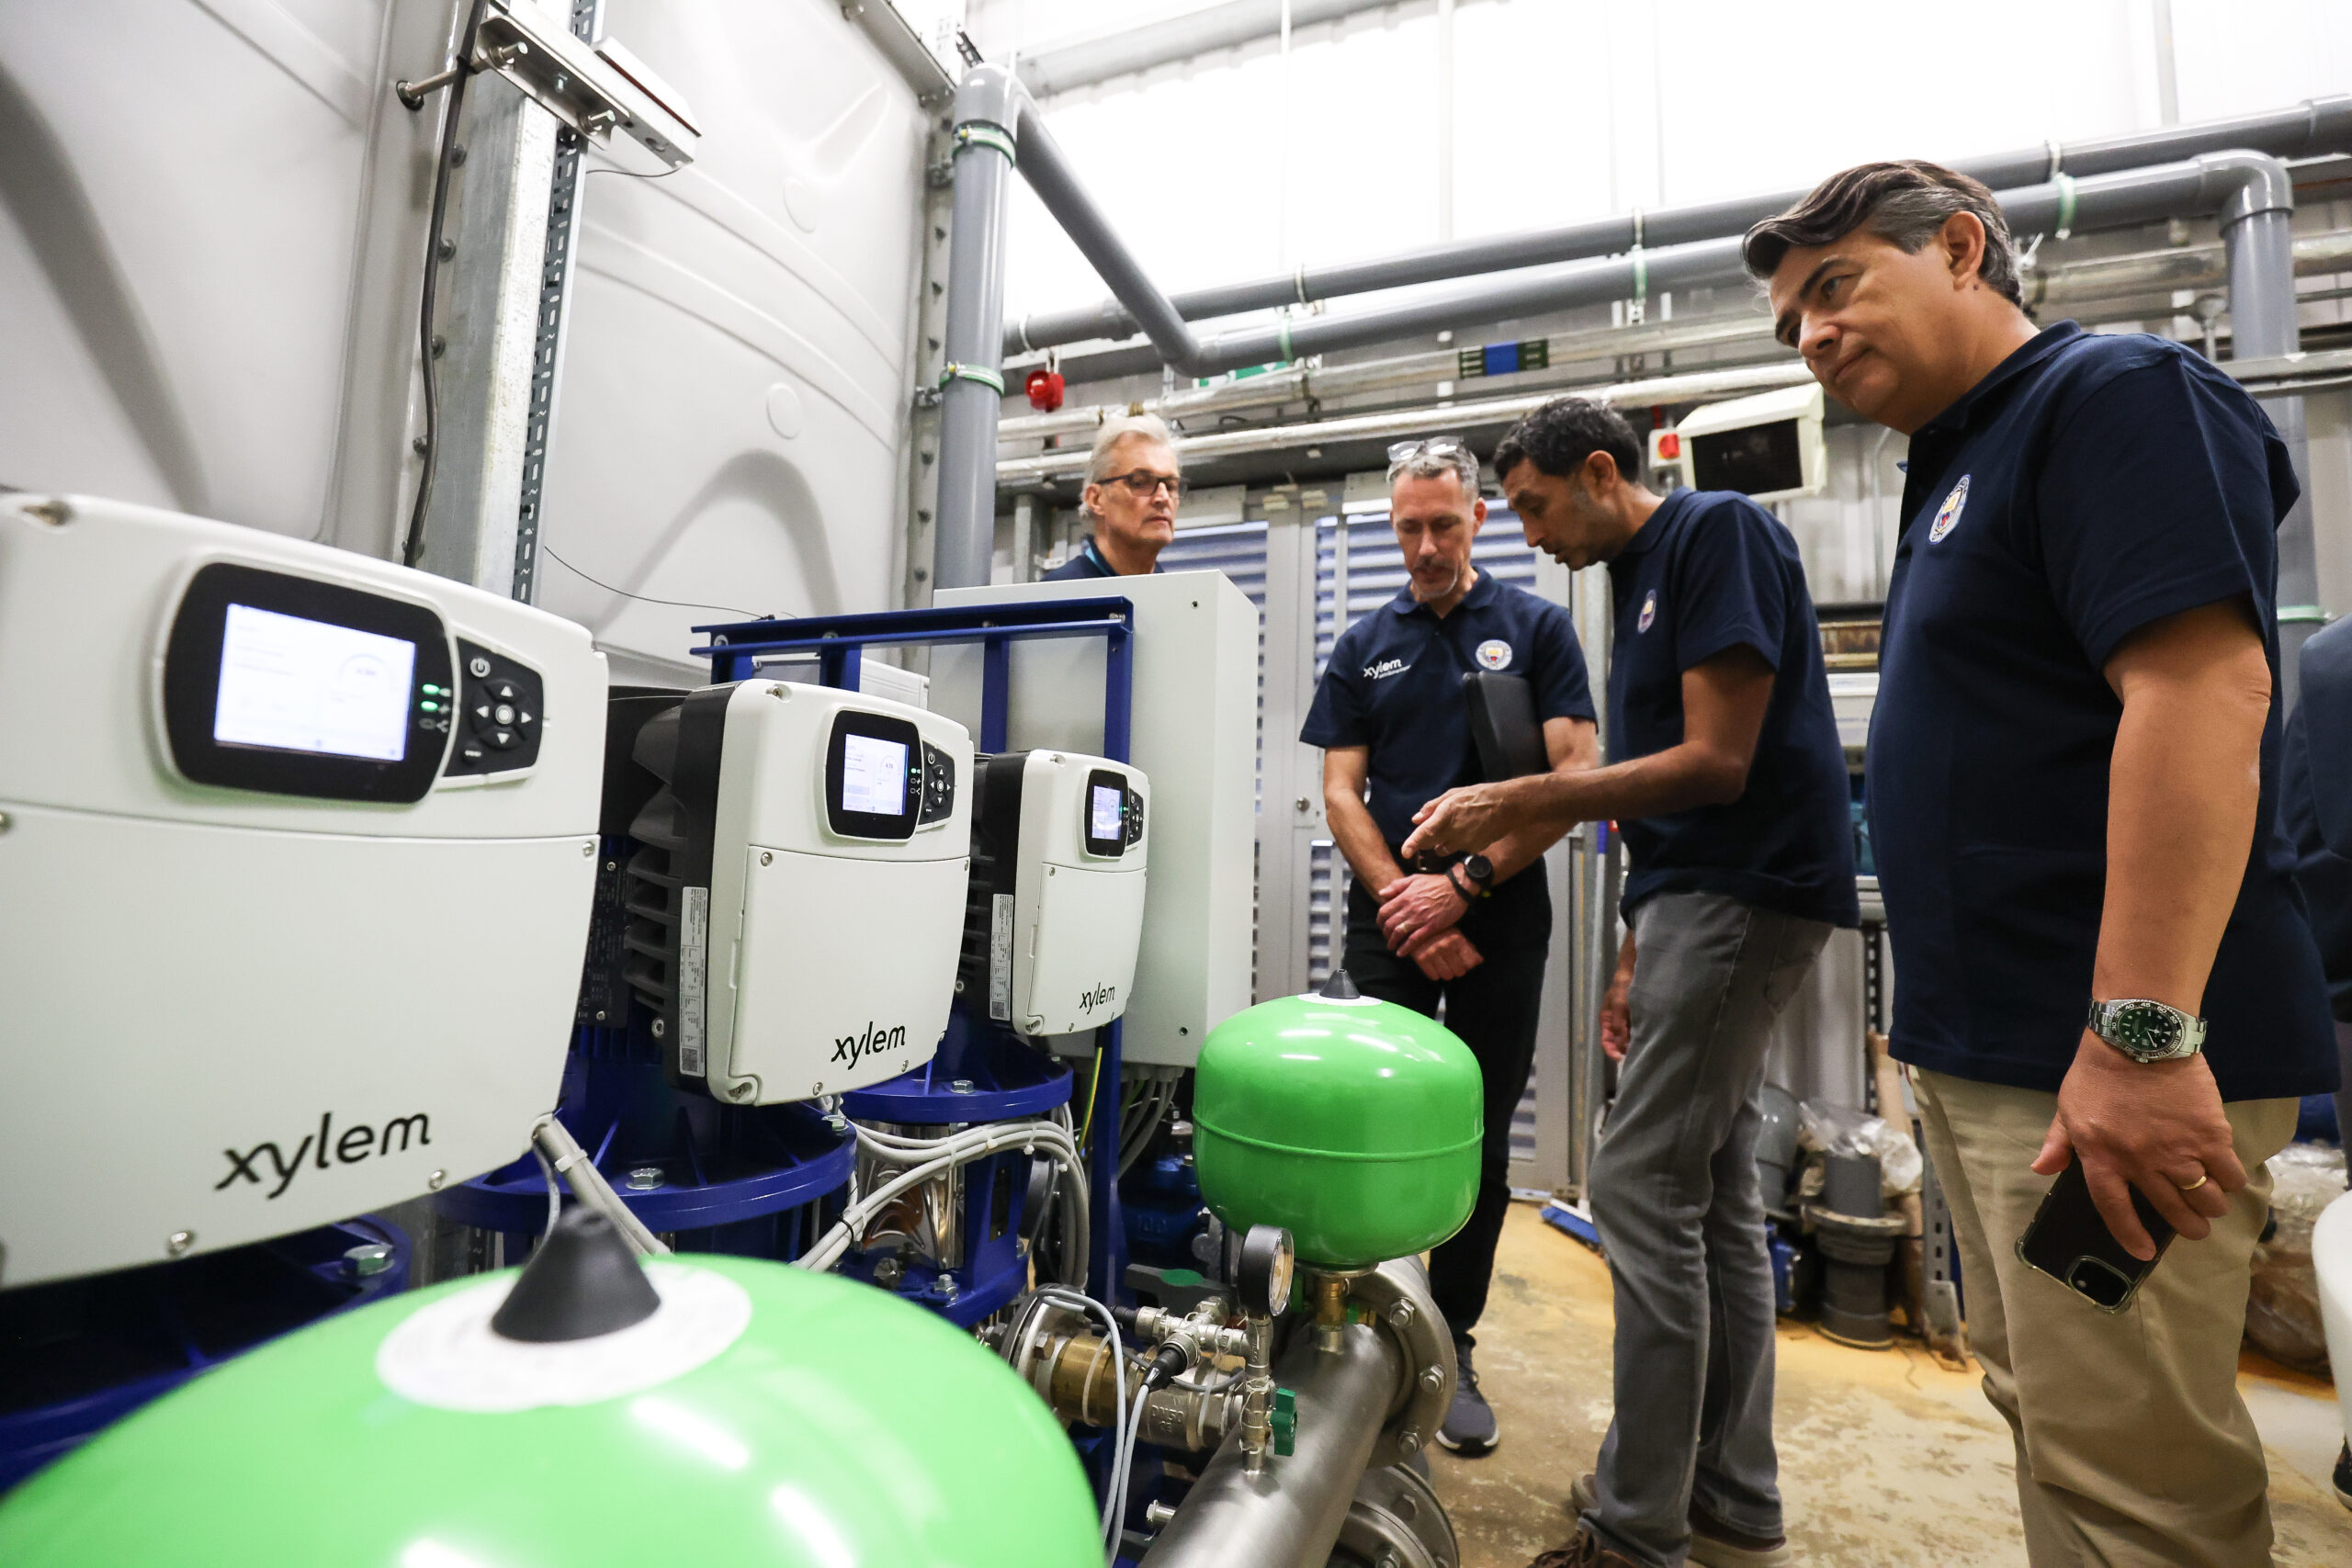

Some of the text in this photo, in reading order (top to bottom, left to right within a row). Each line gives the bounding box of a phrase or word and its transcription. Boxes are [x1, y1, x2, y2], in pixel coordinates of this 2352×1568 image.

[1363, 659, 1402, 680] xylem
[1079, 982, 1115, 1015] xylem
[2156, 1006, 2167, 1014] 50
[831, 1021, 906, 1071] xylem
[215, 1111, 430, 1201] xylem
